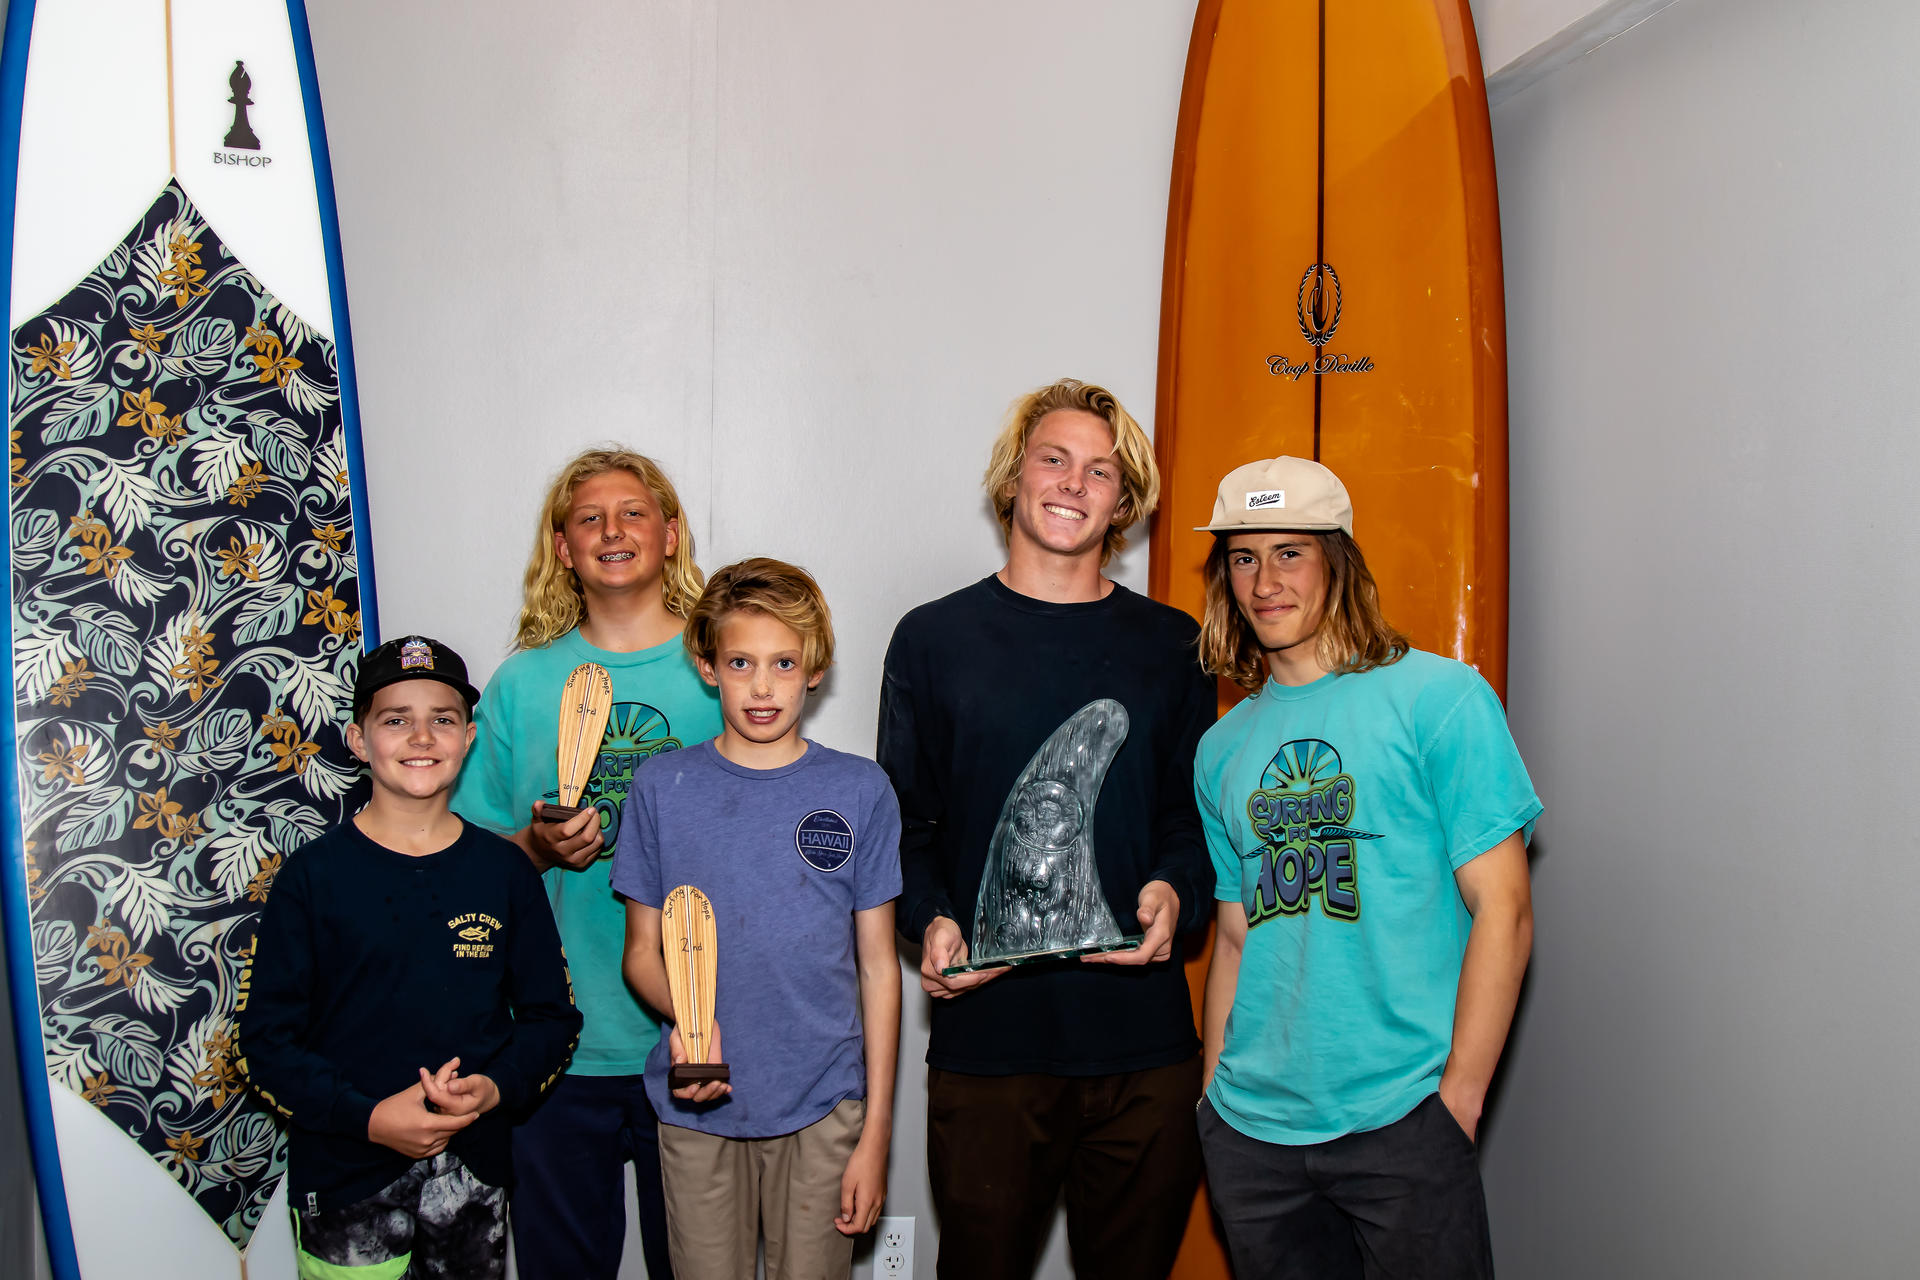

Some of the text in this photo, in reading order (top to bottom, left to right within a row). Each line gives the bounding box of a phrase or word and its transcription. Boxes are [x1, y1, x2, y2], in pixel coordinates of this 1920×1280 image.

[213, 152, 272, 168] BISHOP
[1265, 353, 1375, 382] Coop Deville
[1248, 493, 1281, 508] Esteem
[1251, 779, 1351, 835] SURFNG
[801, 832, 850, 850] HAWAII
[1287, 825, 1310, 843] FO
[665, 888, 686, 919] Surfing
[447, 912, 503, 931] SALTY CREW
[453, 943, 471, 952] FIND
[456, 950, 465, 958] IN
[465, 950, 479, 958] THE
